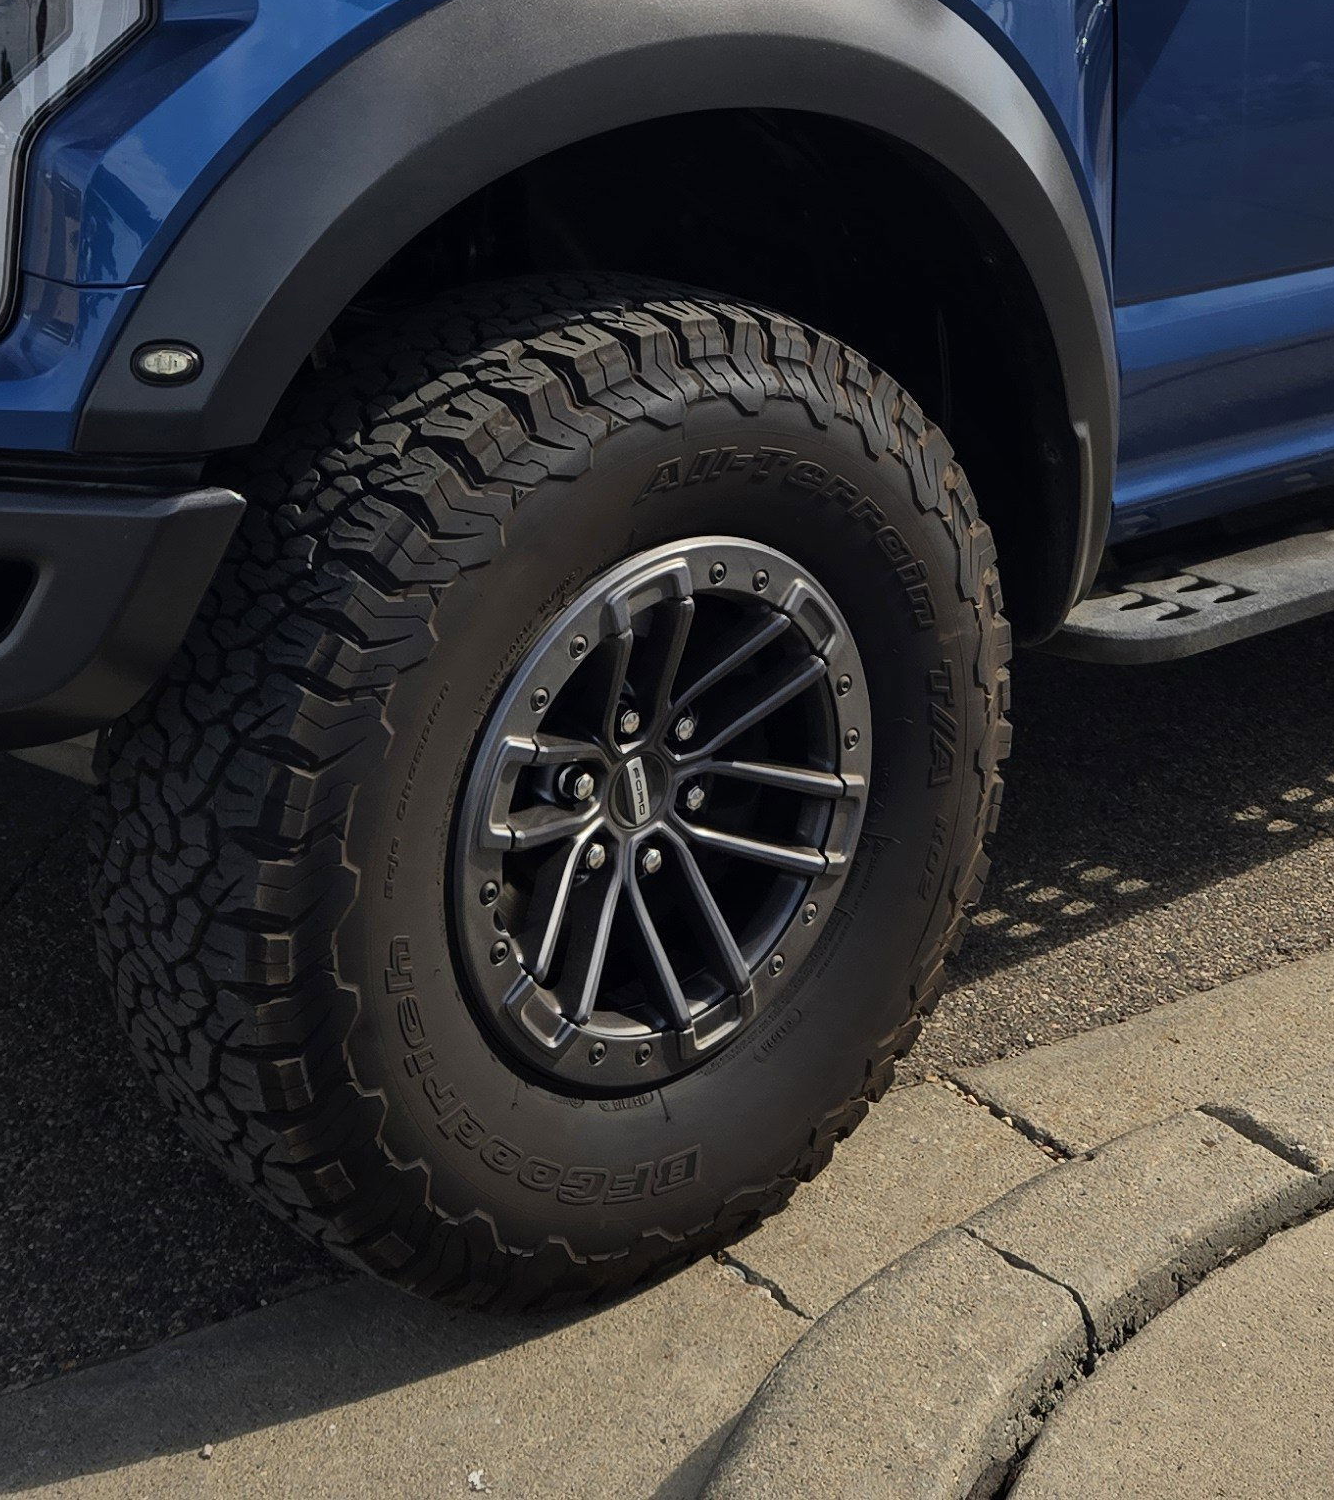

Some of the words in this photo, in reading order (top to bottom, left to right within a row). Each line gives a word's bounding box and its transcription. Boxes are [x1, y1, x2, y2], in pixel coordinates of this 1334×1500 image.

[631, 445, 937, 629] All-Terrain
[927, 658, 960, 789] T/A
[383, 836, 401, 900] Baja
[395, 680, 451, 822] Champion
[633, 767, 646, 816] FORD
[384, 934, 703, 1206] BFGoodrich
